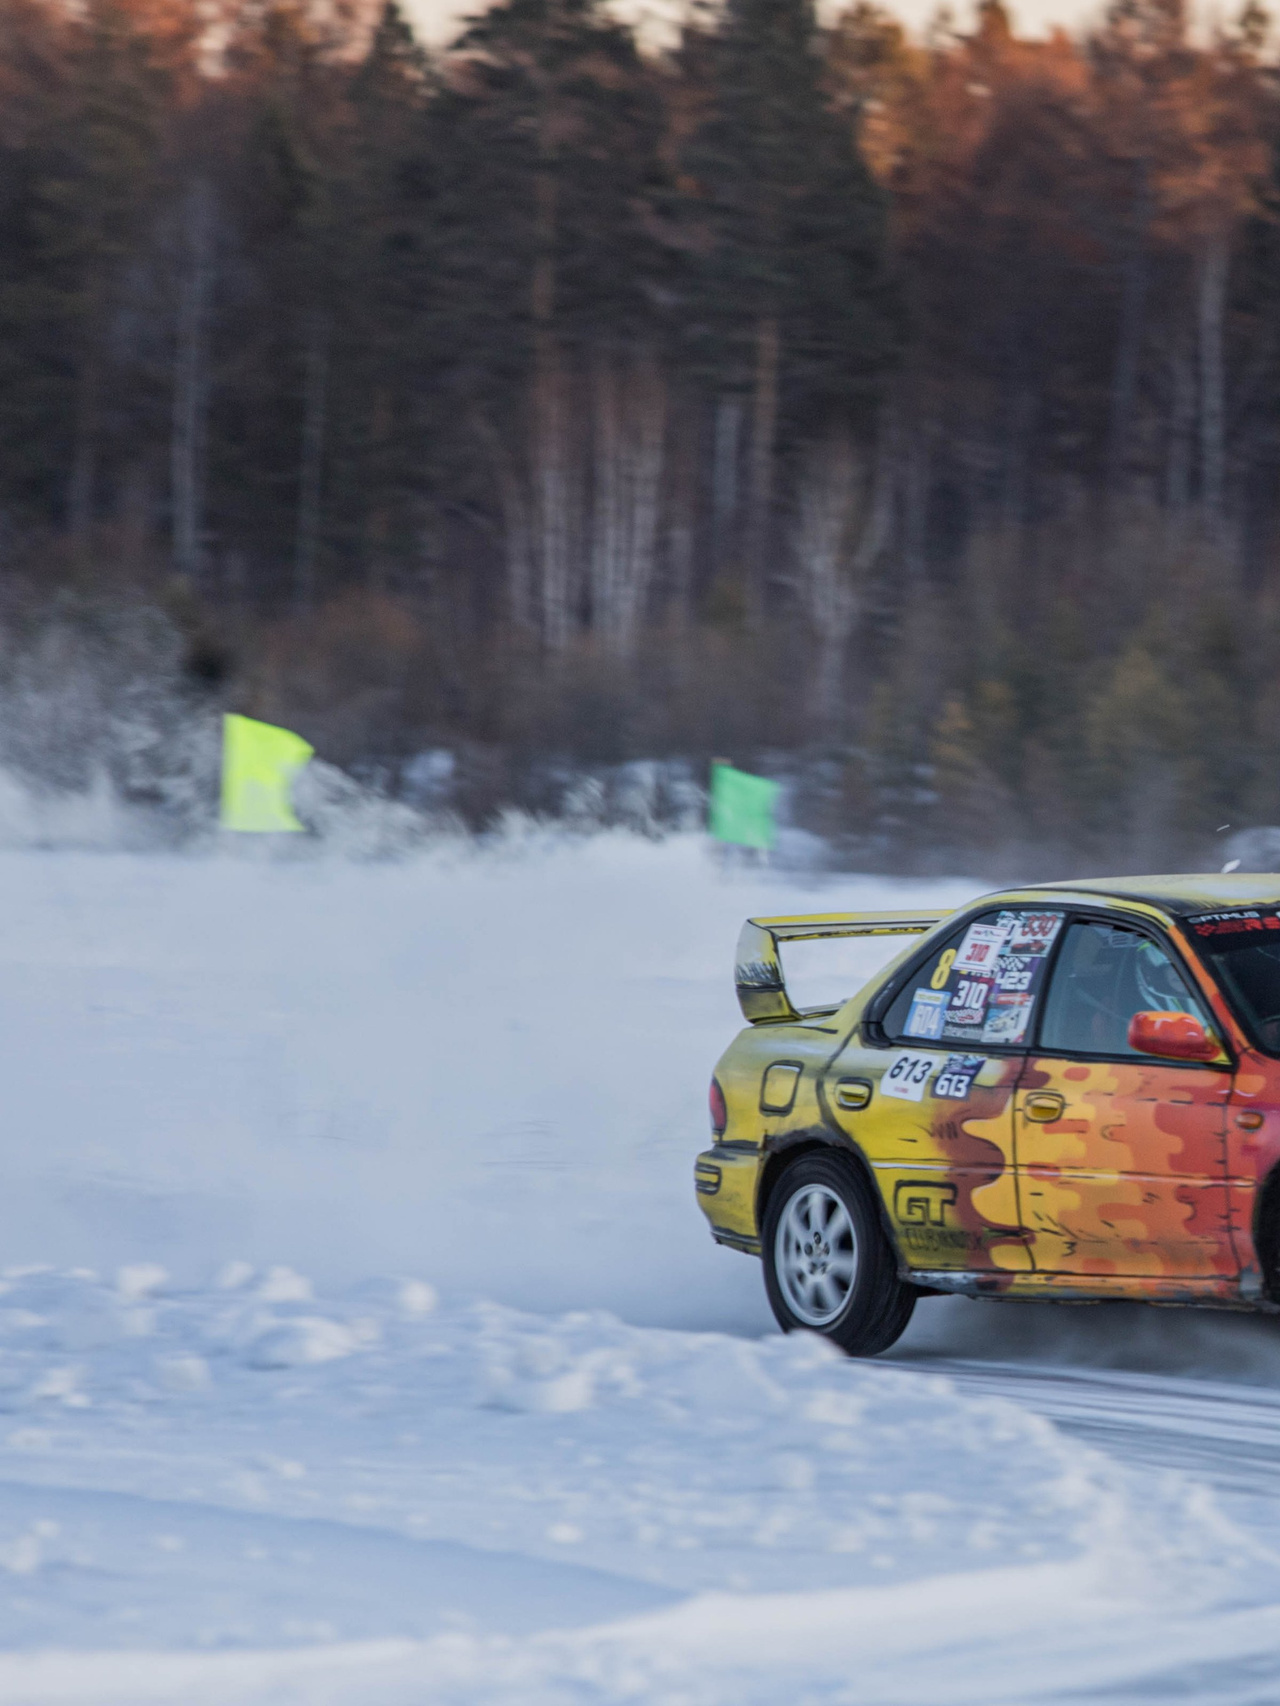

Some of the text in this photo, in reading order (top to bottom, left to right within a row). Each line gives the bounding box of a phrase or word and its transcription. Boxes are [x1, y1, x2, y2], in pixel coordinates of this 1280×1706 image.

[930, 948, 957, 990] 8
[995, 970, 1033, 990] 423
[951, 980, 989, 1009] 310
[889, 1056, 933, 1084] 613
[935, 1073, 971, 1098] 613
[893, 1179, 958, 1227] GT
